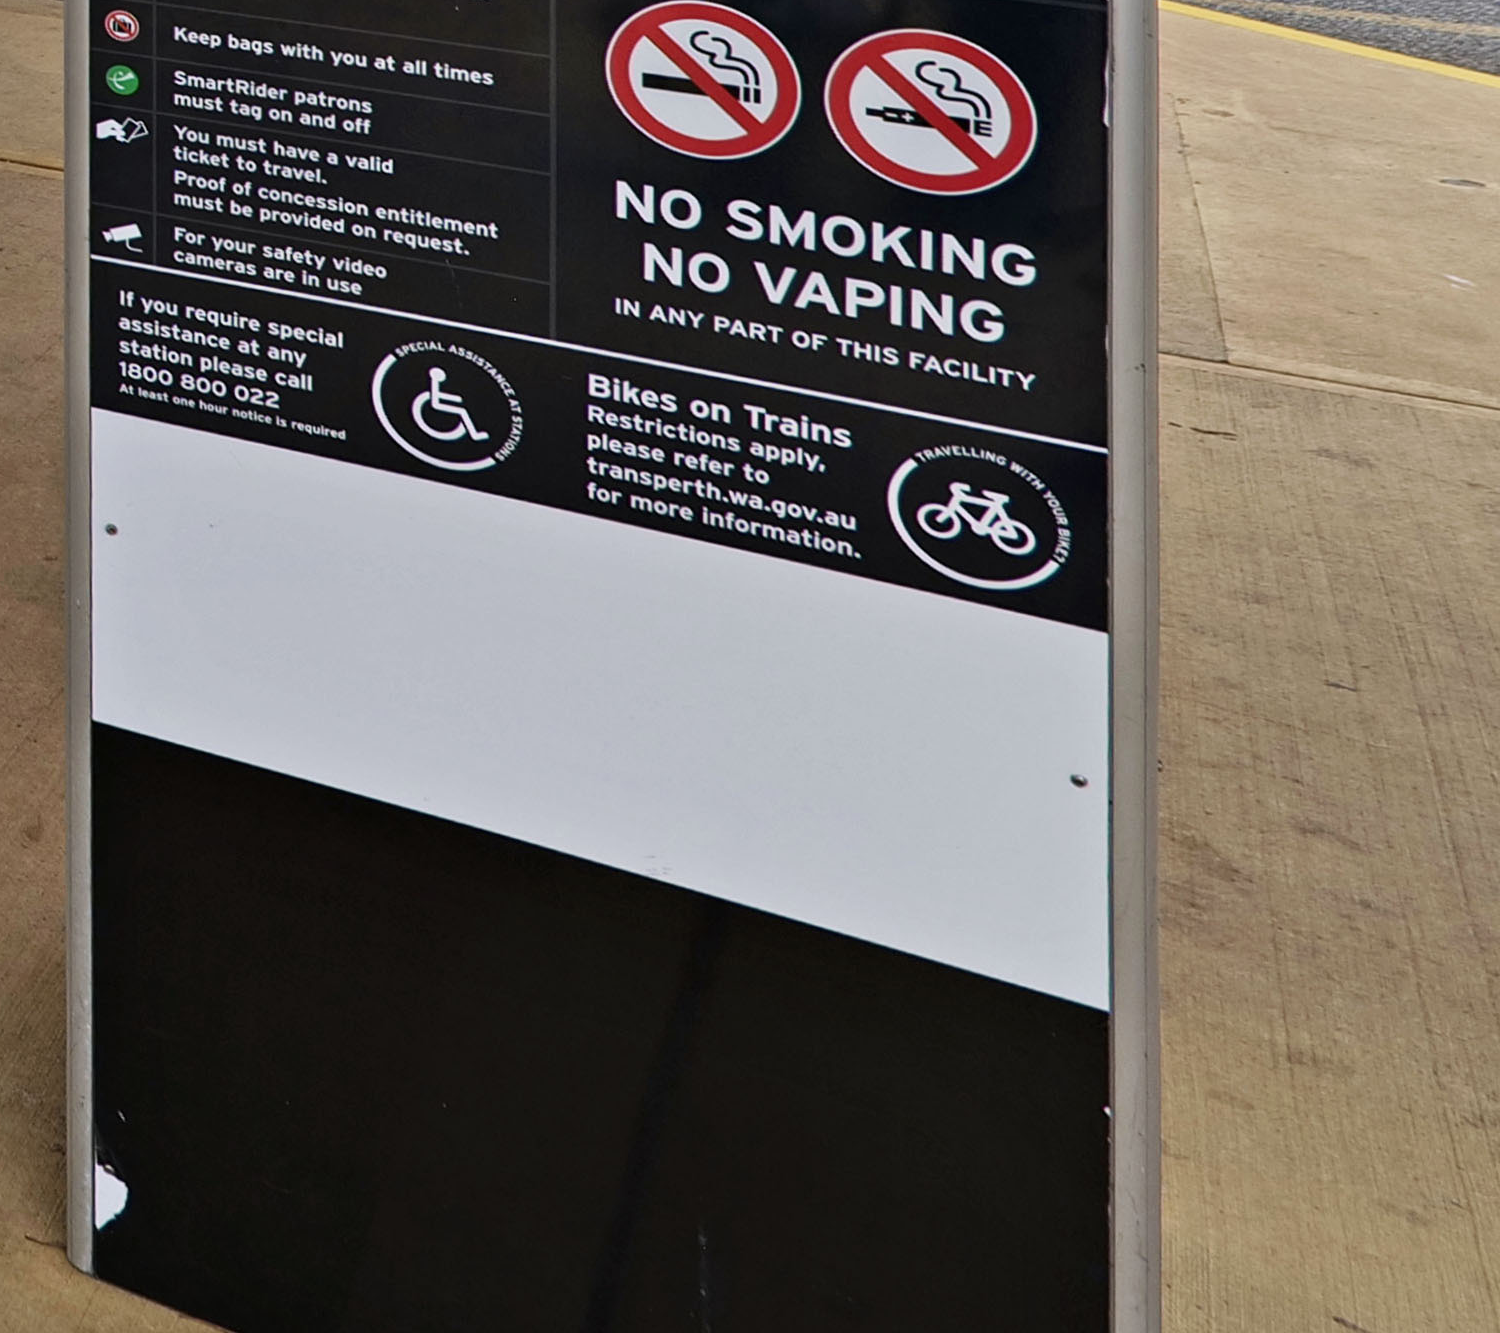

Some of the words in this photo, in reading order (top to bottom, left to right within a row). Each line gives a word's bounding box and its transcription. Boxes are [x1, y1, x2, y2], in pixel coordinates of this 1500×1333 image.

[174, 26, 221, 48] Keep
[228, 34, 274, 55] bags
[280, 43, 324, 61] with
[330, 51, 367, 67] you
[374, 56, 395, 71] at
[402, 60, 427, 76] all
[433, 62, 494, 85] times
[174, 70, 288, 100] SmartRider
[294, 91, 372, 113] patrons
[174, 94, 223, 112] must
[229, 99, 262, 121] tag
[268, 109, 292, 122] on
[299, 113, 336, 129] and
[342, 118, 371, 134] off
[173, 146, 229, 168] ticket
[236, 155, 257, 172] to
[263, 160, 327, 184] travel.
[174, 125, 209, 144] You
[216, 135, 266, 153] must
[273, 141, 320, 162] have
[327, 152, 338, 165] a
[345, 155, 393, 174] valid
[174, 170, 226, 192] Proof
[232, 181, 252, 196] of
[258, 187, 369, 216] concession
[375, 207, 498, 239] entitlement
[174, 193, 223, 212] must
[230, 200, 253, 217] be
[260, 208, 345, 233] provided
[351, 224, 376, 239] on
[384, 229, 470, 255] request.
[616, 180, 701, 229] NO
[726, 200, 1036, 286] SMOKING
[173, 251, 257, 276] cameras
[263, 267, 295, 283] are
[302, 270, 320, 287] in
[327, 278, 362, 295] use
[174, 227, 206, 245] For
[211, 236, 256, 254] your
[263, 246, 326, 270] safety
[332, 257, 387, 278] video
[120, 290, 134, 307] If
[141, 298, 178, 316] you
[186, 306, 261, 332] require
[268, 322, 343, 348] special
[644, 243, 730, 293] NO
[754, 261, 1004, 342] VAPING
[119, 317, 230, 350] assistance
[237, 340, 260, 356] at
[267, 346, 307, 368] any
[119, 340, 193, 366] station
[200, 356, 268, 382] please
[275, 372, 312, 391] call
[615, 298, 640, 317] IN
[649, 305, 704, 328] ANY
[714, 316, 783, 343] PART
[792, 331, 828, 350] OF
[836, 338, 899, 365] THIS
[909, 352, 1035, 390] FACILITY
[119, 361, 173, 386] 1800
[180, 374, 227, 397] 800
[234, 385, 279, 409] 022
[119, 383, 134, 395] At
[138, 387, 169, 402] least
[172, 396, 195, 408] one
[199, 399, 228, 414] hour
[232, 409, 272, 424] notice
[276, 416, 287, 427] is
[291, 421, 346, 440] required
[589, 374, 677, 412] Bikes
[690, 400, 730, 423] on
[743, 404, 852, 447] Trains
[587, 433, 665, 462] please
[674, 452, 735, 476] refer
[742, 463, 770, 484] to
[588, 405, 740, 452] Restrictions
[750, 442, 825, 472] apply,
[587, 457, 856, 530] transperth.wa.gov.au
[587, 482, 622, 504] for
[630, 495, 693, 521] more
[703, 506, 861, 558] information.
